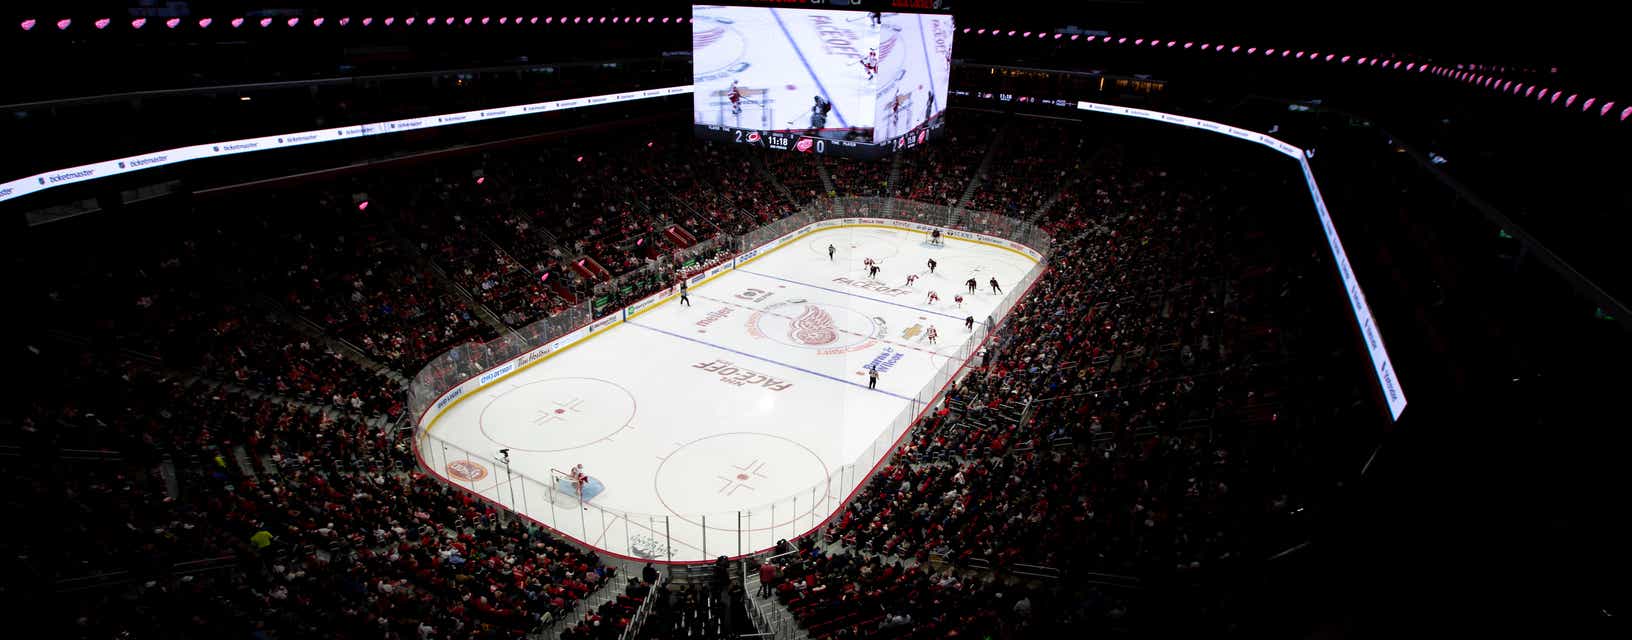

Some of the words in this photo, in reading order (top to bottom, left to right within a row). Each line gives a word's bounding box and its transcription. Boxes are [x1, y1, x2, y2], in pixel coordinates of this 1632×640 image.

[735, 130, 743, 143] 2
[768, 135, 788, 146] 11:18
[816, 140, 825, 153] 0
[130, 155, 168, 168] ticketmaster
[49, 169, 94, 183] ticketmaster
